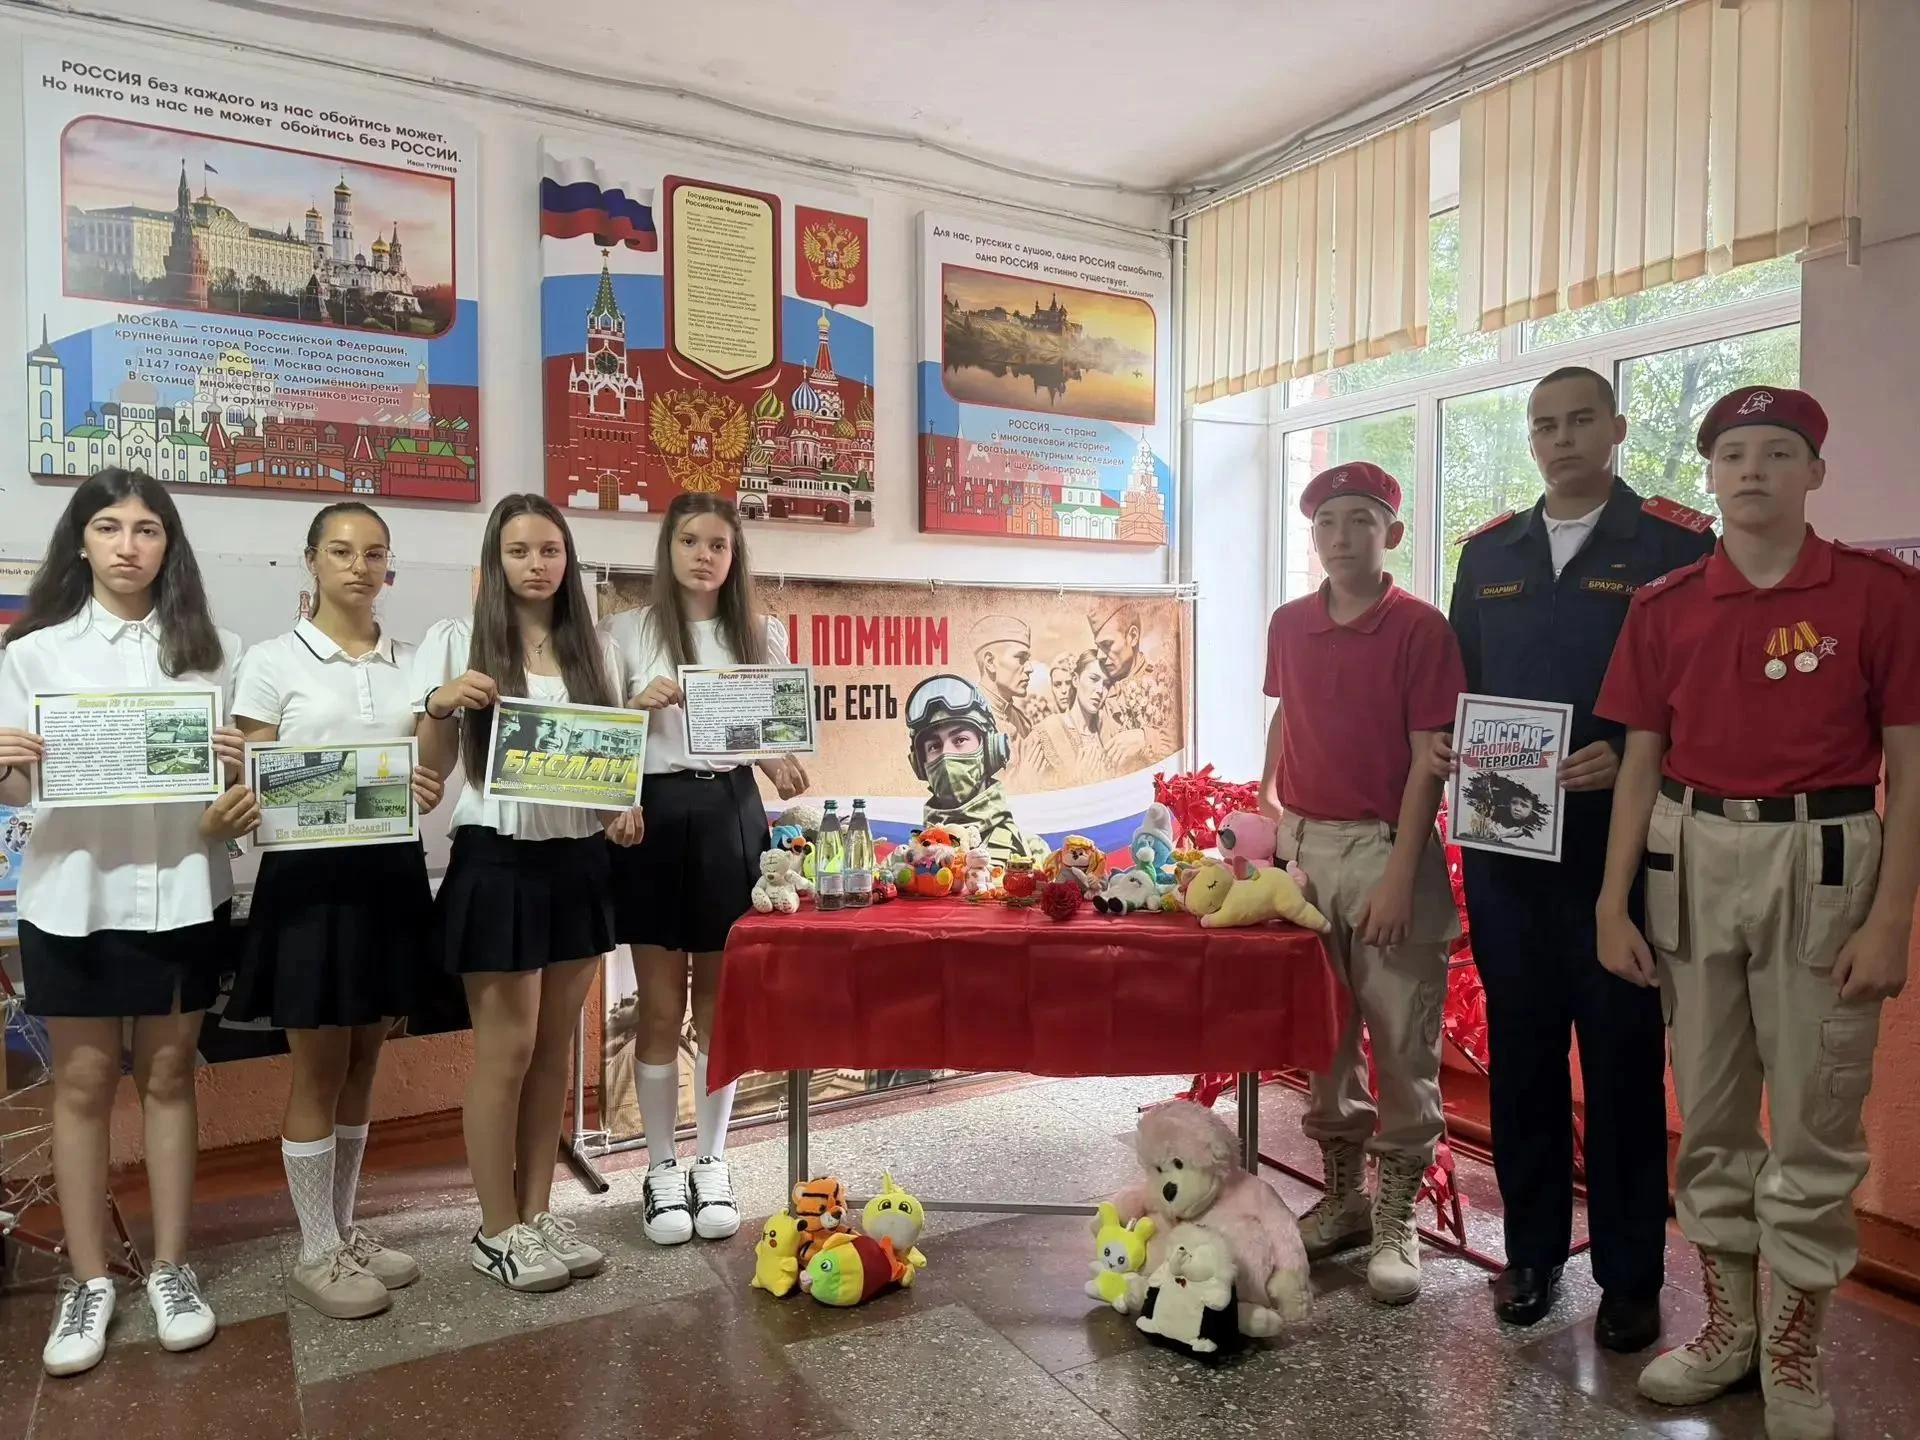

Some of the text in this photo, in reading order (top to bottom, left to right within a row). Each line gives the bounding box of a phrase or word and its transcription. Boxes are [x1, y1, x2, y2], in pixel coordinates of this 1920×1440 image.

[62, 60, 447, 144] РОССИЯ без каждого из нас обойтись может.
[42, 75, 462, 163] Но никто из нас не может обойтись без РОССИИ.
[686, 198, 723, 211] Российской
[933, 226, 950, 238] Для
[953, 231, 973, 243] нас,
[976, 235, 1012, 250] русских
[1056, 251, 1076, 262] одна
[1079, 254, 1115, 270] РОССИЯ
[1117, 263, 1164, 280] самобытна,
[976, 252, 1128, 288] одна РОССИЯ истинно существует.
[115, 329, 410, 368] крупнейший город России. Город расположен
[117, 313, 178, 329] МОСКВА
[201, 324, 253, 338] столица
[258, 329, 332, 347] Российской
[336, 339, 408, 356] Федерации,
[138, 358, 170, 369] 1147
[175, 363, 202, 375] году
[208, 366, 223, 375] на
[228, 367, 279, 381] берегах
[146, 346, 384, 378] на западе России. Москва основана
[129, 371, 400, 405] В столице множество памятников истории
[221, 394, 317, 411] и архитектуры.
[991, 432, 997, 440] с
[1000, 433, 1065, 447] многовековой
[1008, 419, 1050, 432] РОССИЯ
[1064, 428, 1097, 438] страна
[977, 442, 1018, 455] богатым
[1021, 449, 1074, 462] культурным
[1014, 463, 1050, 473] щедрой
[811, 614, 949, 666] ПОМНИМ
[845, 684, 898, 721] ЕСТЬ
[1470, 741, 1522, 757] ПРОТИВ
[1472, 719, 1544, 750] РОССИЯ
[502, 749, 632, 784] БЕСЛАН
[1479, 752, 1540, 769] ТЕРРОРА!
